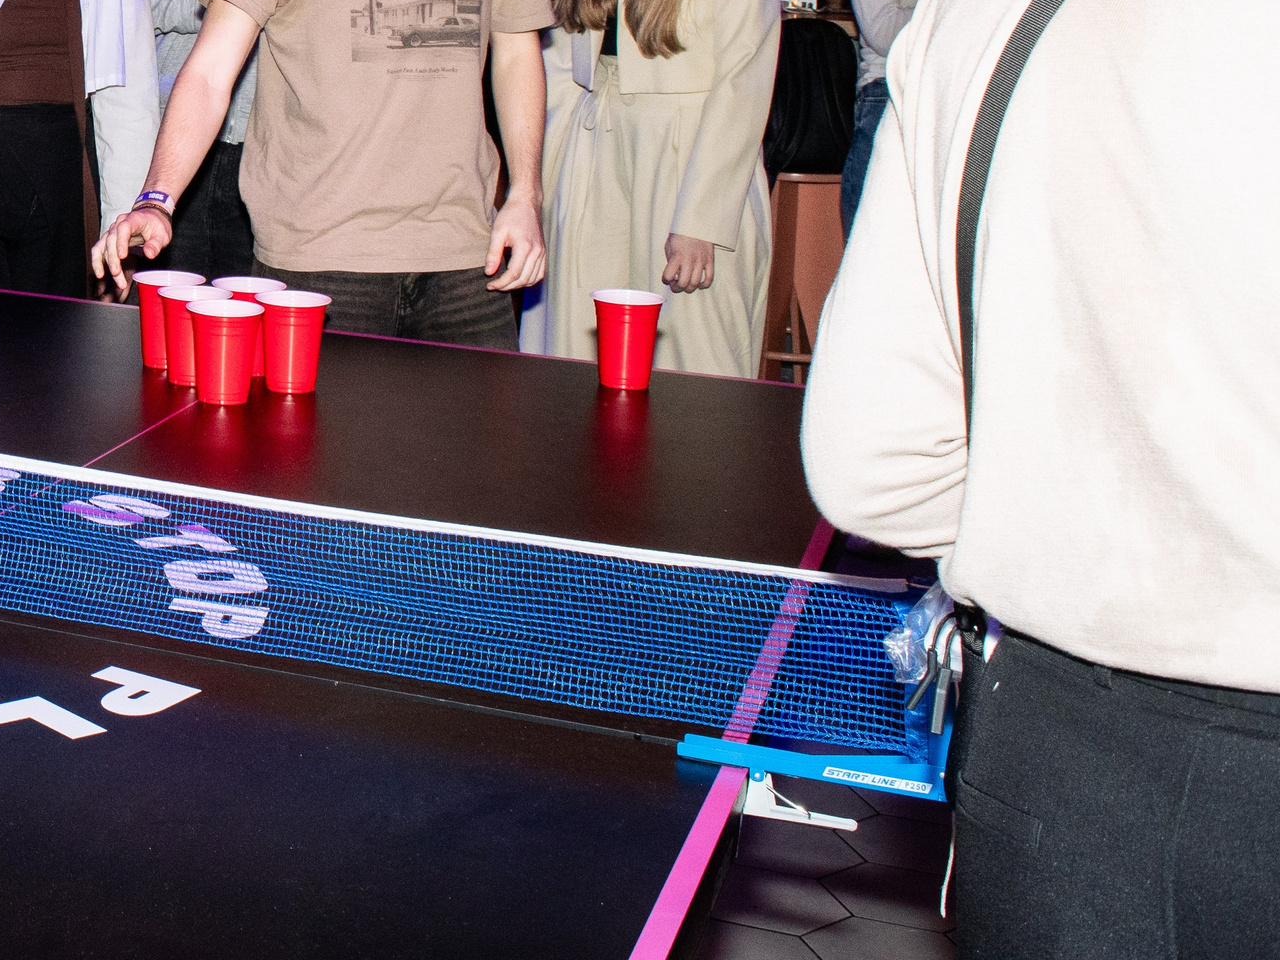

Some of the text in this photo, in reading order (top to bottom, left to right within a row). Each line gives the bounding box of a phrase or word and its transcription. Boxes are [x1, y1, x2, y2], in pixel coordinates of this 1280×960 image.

[62, 494, 270, 640] STOP
[826, 768, 928, 792] START LINE P250
